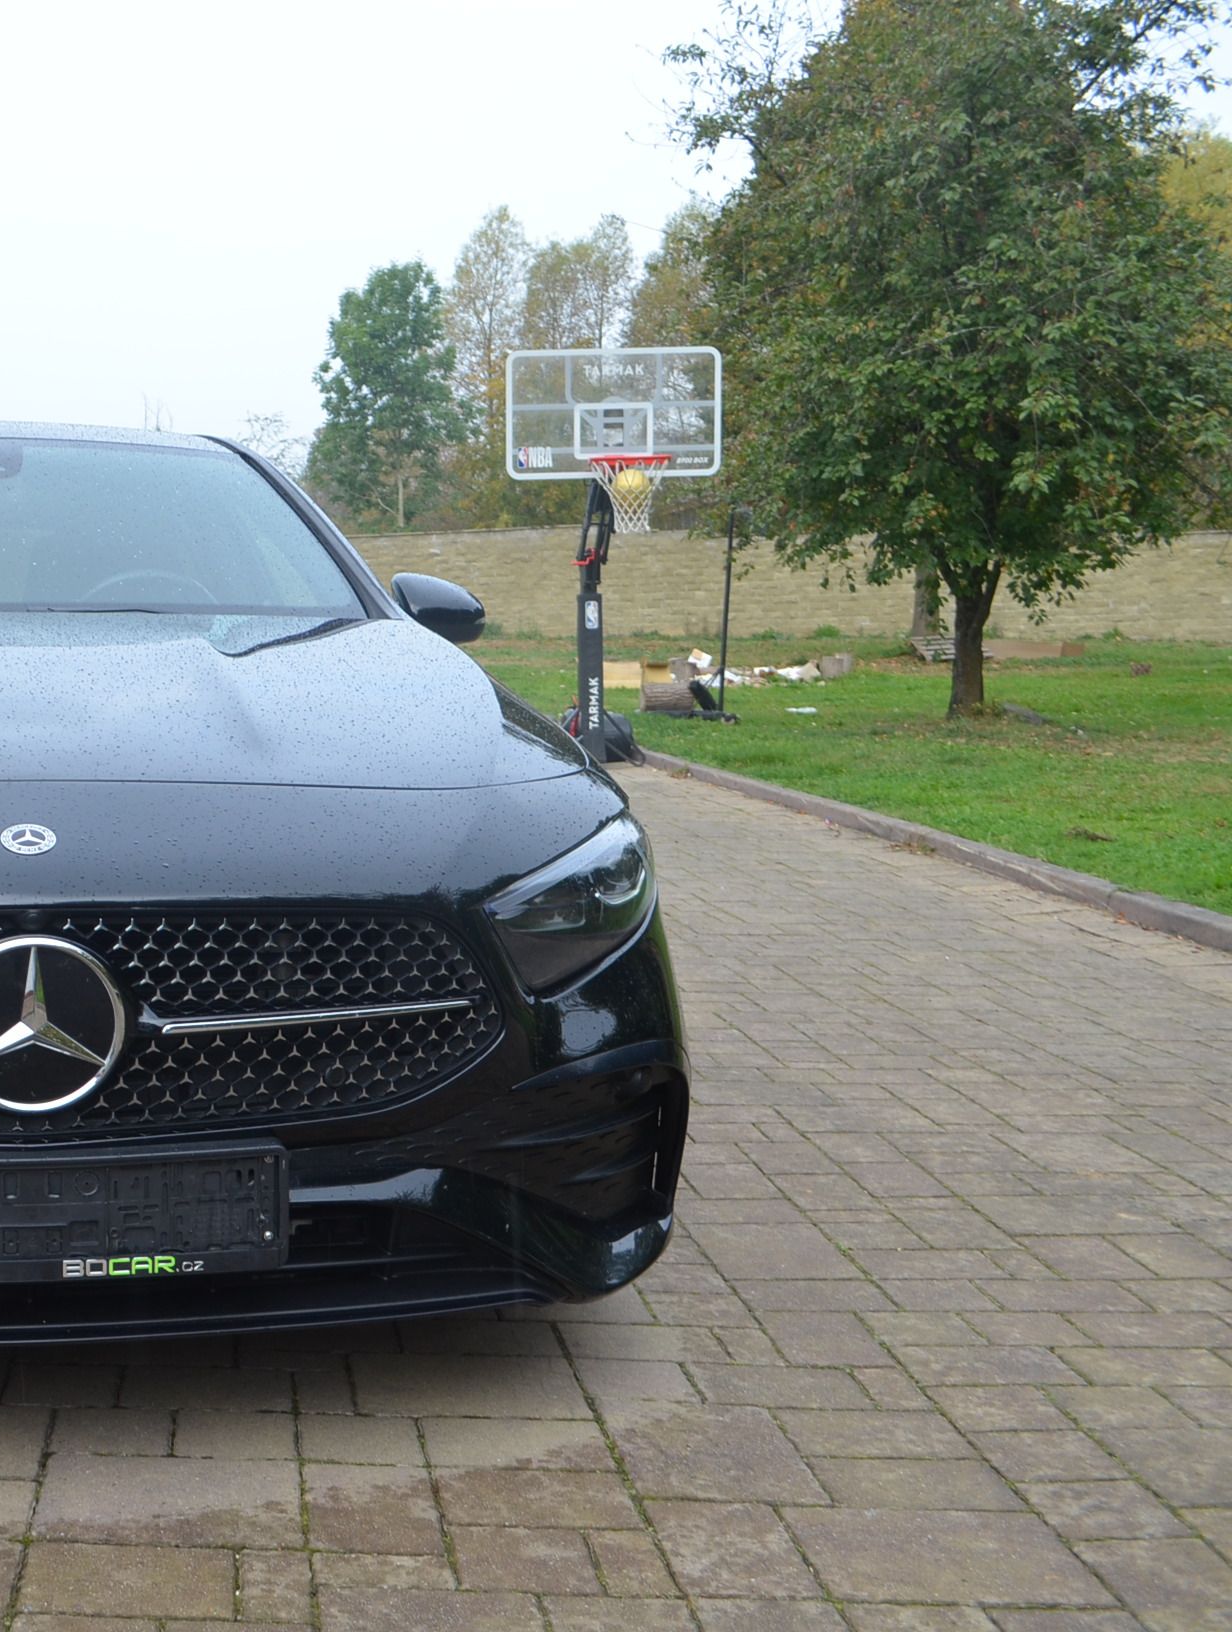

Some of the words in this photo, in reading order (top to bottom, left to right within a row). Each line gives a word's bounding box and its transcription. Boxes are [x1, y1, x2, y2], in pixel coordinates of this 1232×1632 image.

[583, 364, 645, 376] TARMAK
[528, 446, 553, 468] NBA
[588, 677, 599, 730] TARMAK
